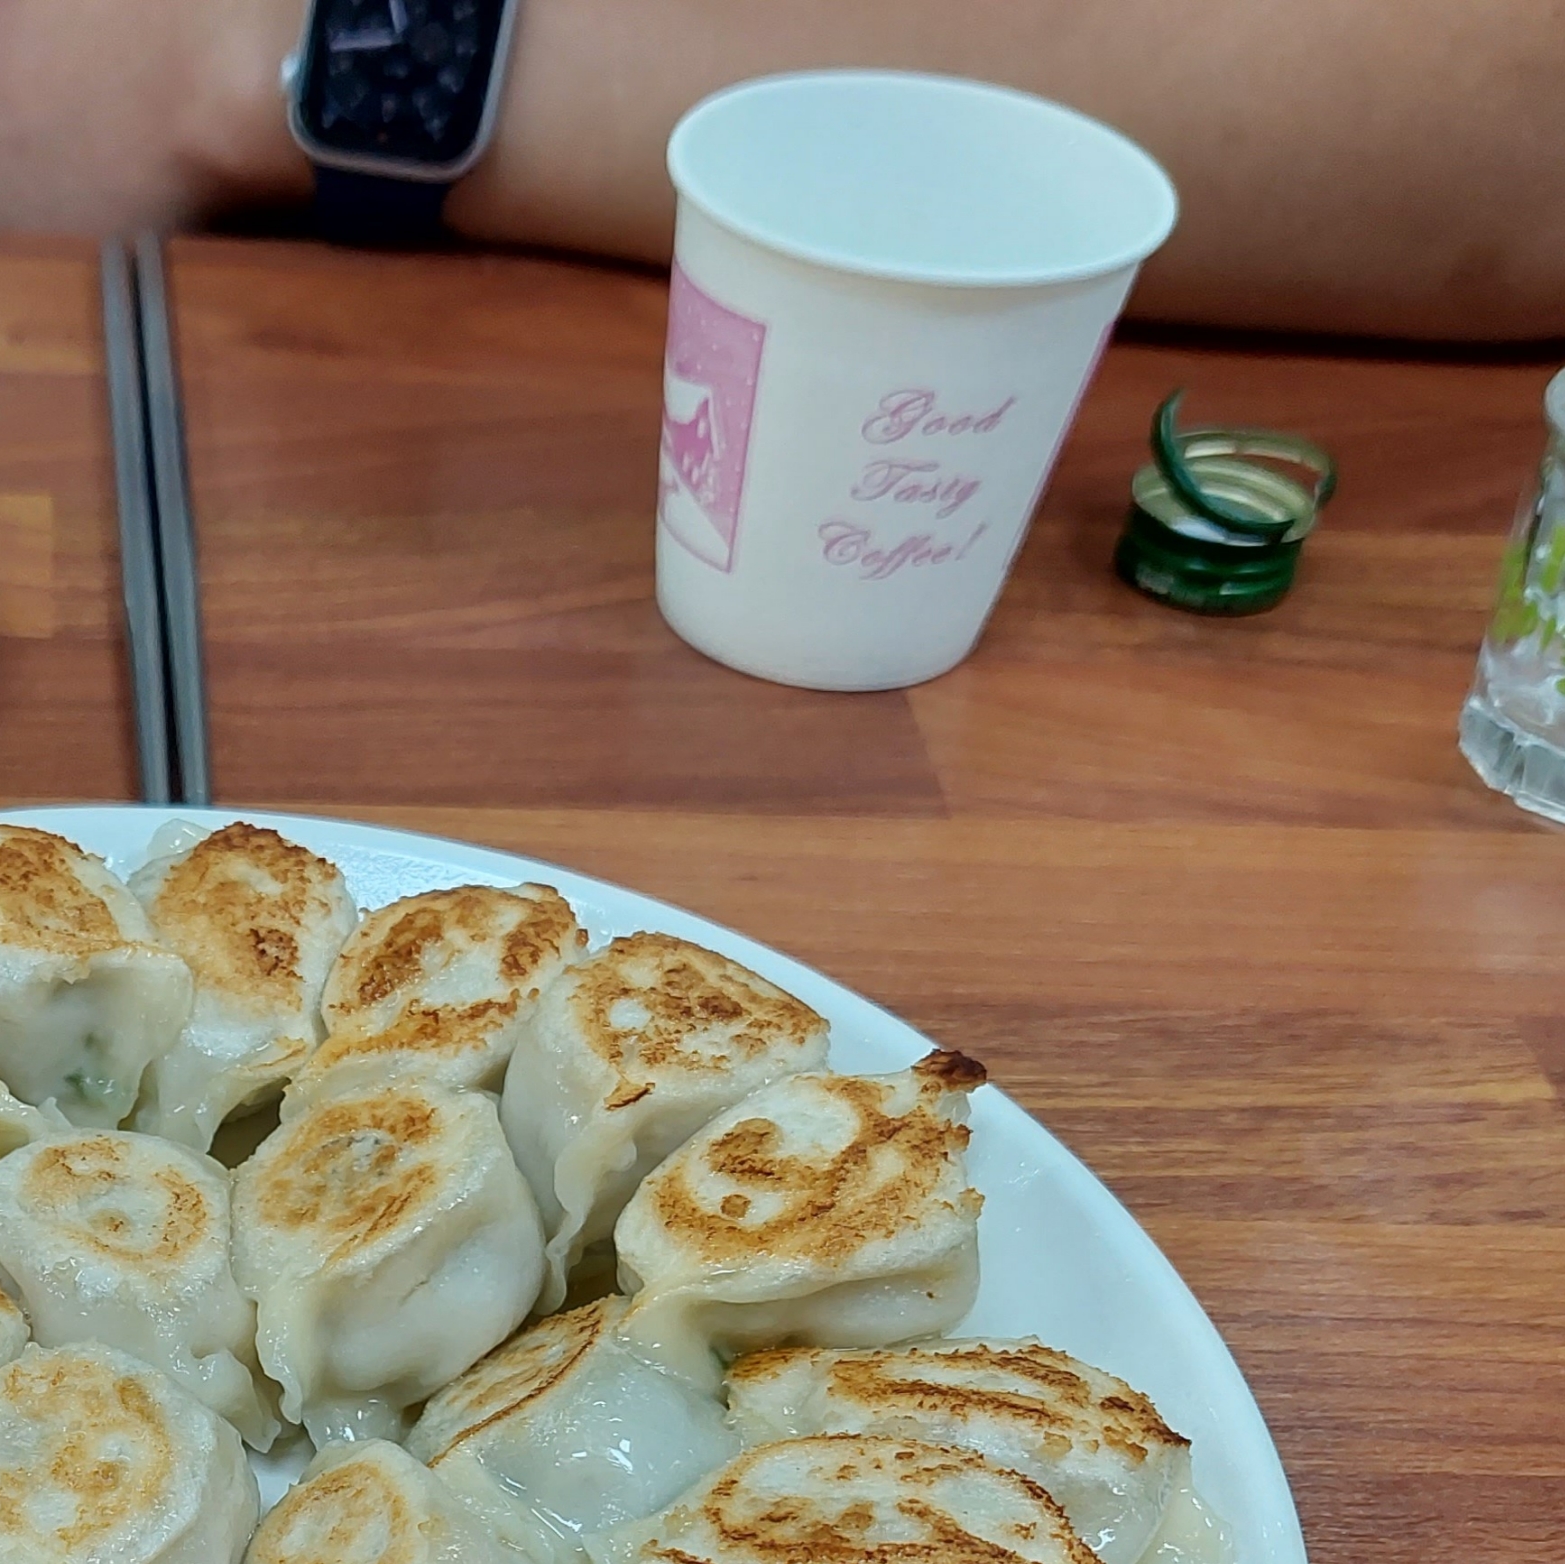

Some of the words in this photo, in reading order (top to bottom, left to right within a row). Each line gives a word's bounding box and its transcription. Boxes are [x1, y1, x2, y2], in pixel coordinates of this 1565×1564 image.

[861, 389, 1016, 444] Good
[850, 460, 982, 518] Tasty
[817, 522, 987, 581] Coffee!
